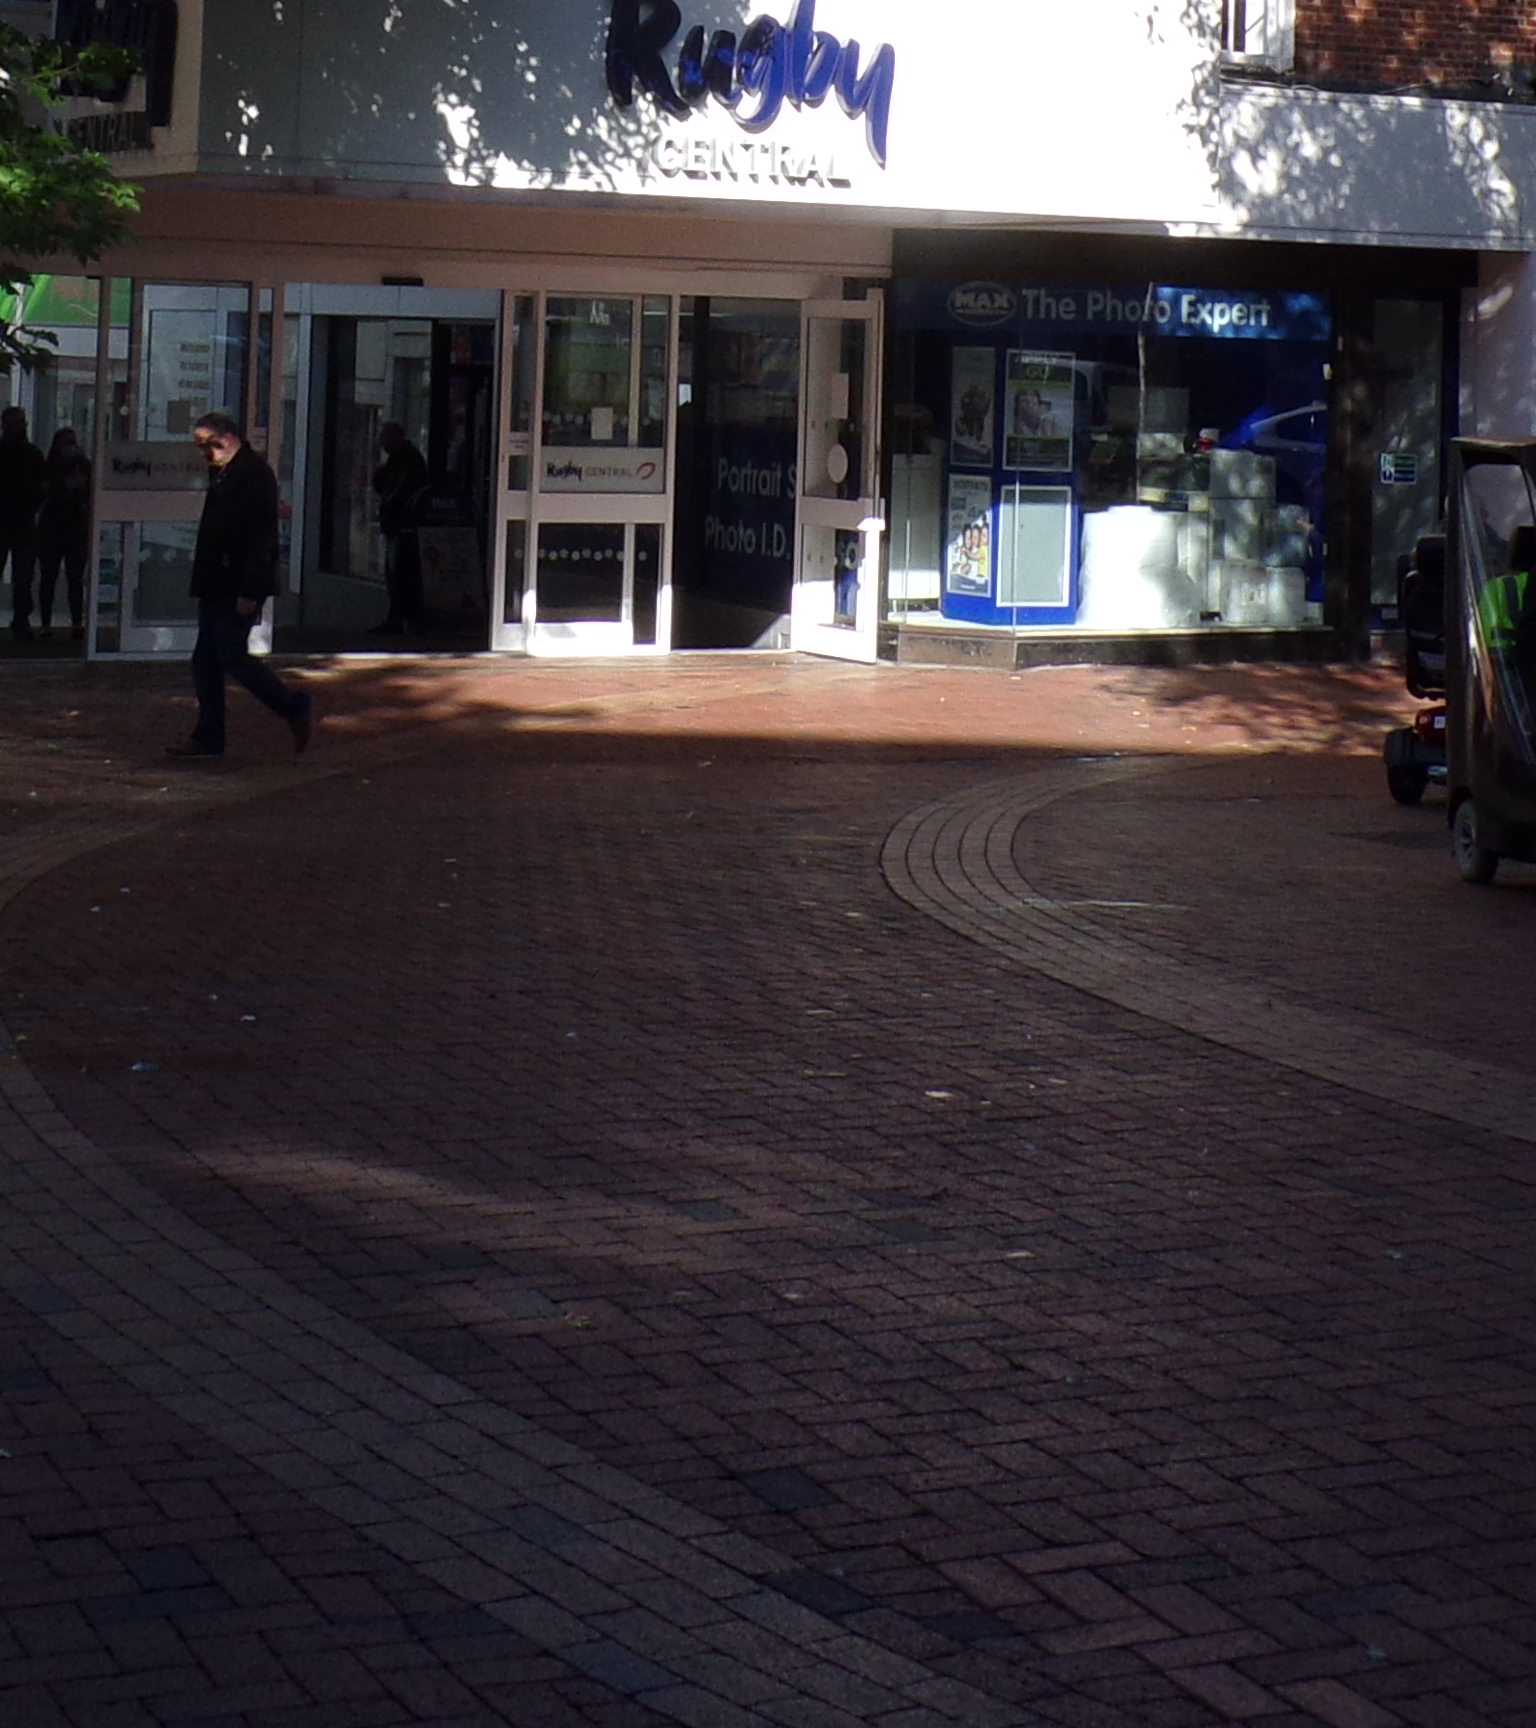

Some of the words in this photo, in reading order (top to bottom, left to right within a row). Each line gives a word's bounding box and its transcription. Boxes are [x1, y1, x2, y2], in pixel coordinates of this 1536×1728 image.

[652, 138, 851, 189] CENTRAL
[955, 291, 1009, 309] MAX
[1022, 288, 1077, 321] The
[1086, 290, 1171, 324] Photo
[1181, 293, 1271, 333] Expert
[547, 459, 583, 482] Rugby
[717, 457, 782, 498] Portrait
[705, 515, 757, 554] Photo
[761, 522, 792, 561] I.D.
